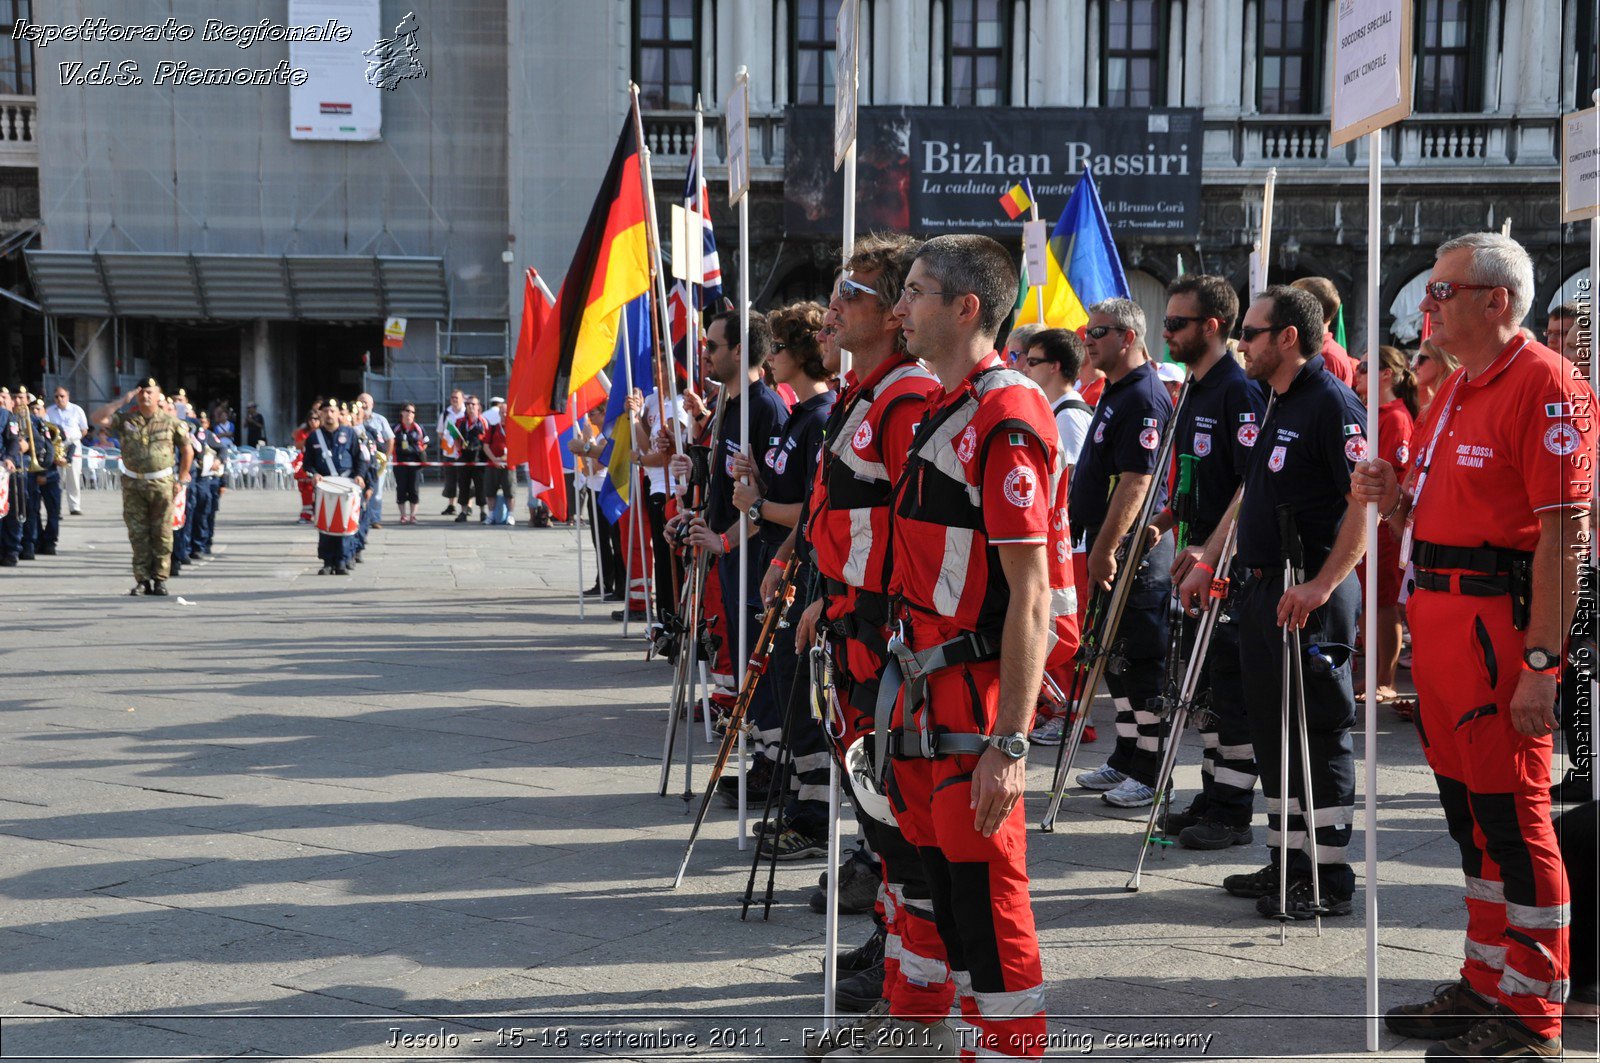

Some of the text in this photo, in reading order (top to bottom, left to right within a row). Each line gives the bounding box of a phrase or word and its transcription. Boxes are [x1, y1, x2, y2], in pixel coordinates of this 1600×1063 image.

[1341, 25, 1367, 49] SOCCORSI
[1367, 10, 1392, 34] SPECIALI
[1343, 53, 1387, 86] UNITA' CINOFILE
[921, 140, 1191, 176] Bizhan Bassiri
[1569, 149, 1592, 163] COMITATO
[921, 179, 942, 194] La
[945, 178, 996, 195] caduta
[1105, 200, 1185, 213] di Bruno Corà
[946, 218, 993, 229] Archeologico
[1130, 220, 1165, 229] Novembre
[1471, 445, 1494, 459] ROSSA
[1456, 455, 1484, 469] ITALIANA
